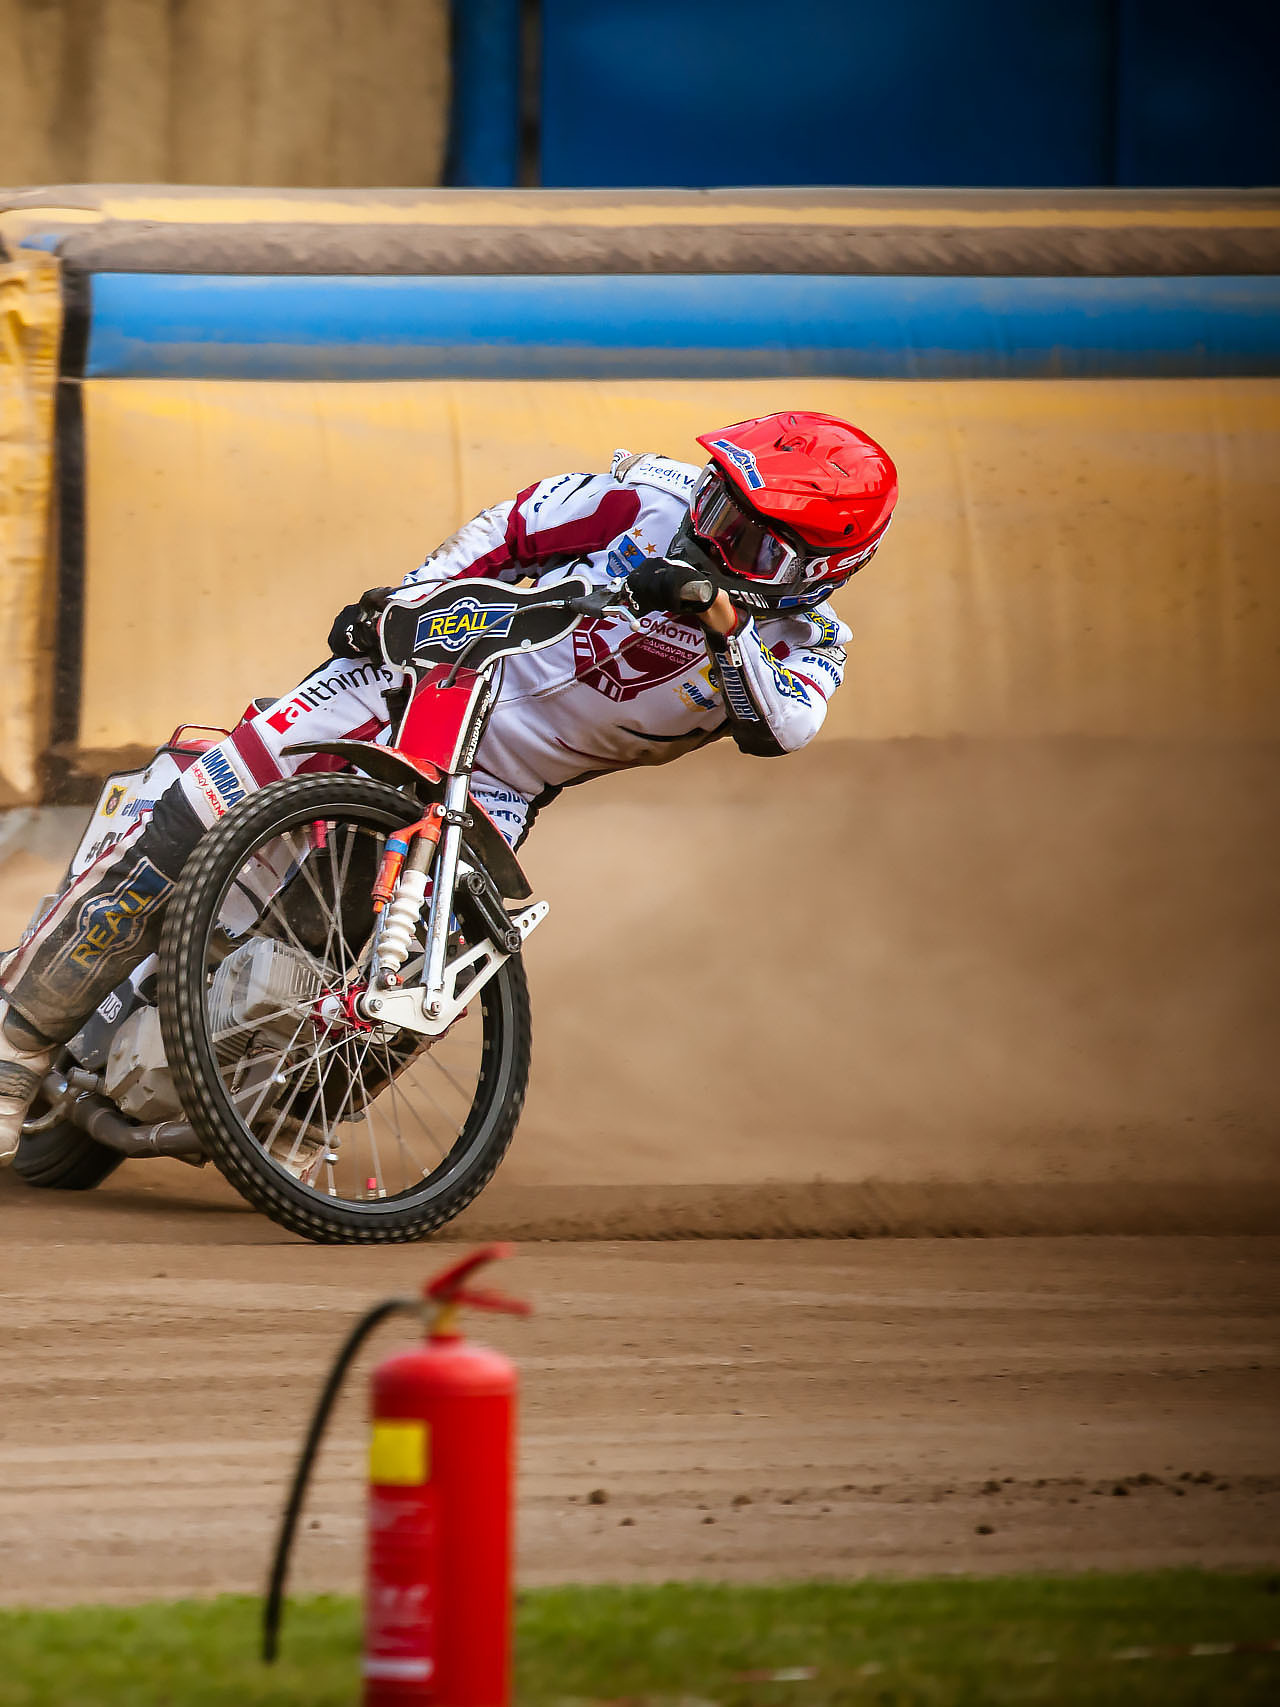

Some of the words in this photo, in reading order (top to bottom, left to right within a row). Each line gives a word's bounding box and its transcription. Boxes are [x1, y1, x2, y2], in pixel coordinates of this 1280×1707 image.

[428, 611, 489, 637] REALL
[640, 617, 705, 647] OMOTIV
[70, 889, 154, 970] REALL
